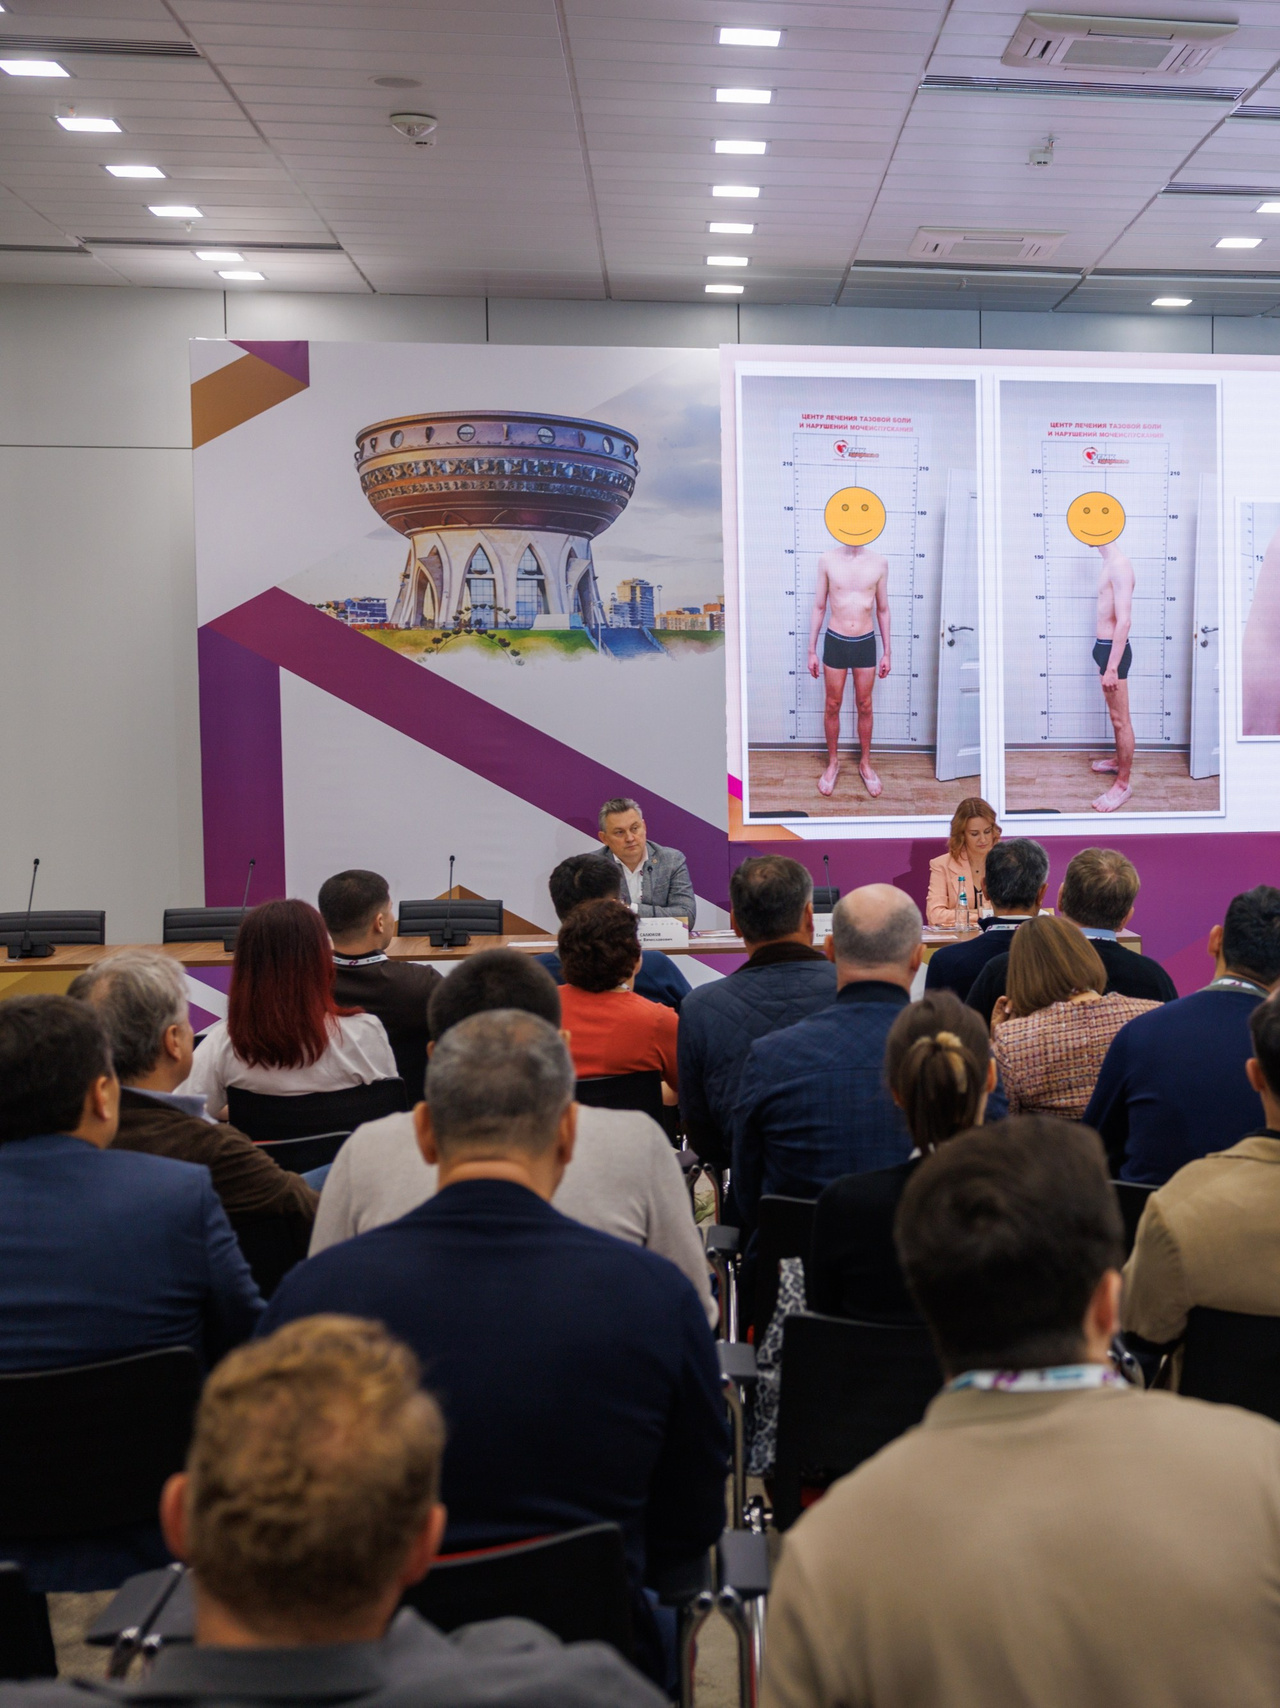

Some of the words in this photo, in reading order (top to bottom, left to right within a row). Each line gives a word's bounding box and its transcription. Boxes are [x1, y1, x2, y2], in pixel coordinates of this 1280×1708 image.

[859, 415, 891, 423] ТАЗОВОЙ
[805, 422, 848, 430] НАРУШЕНИЙ
[849, 424, 914, 433] МОЧЕИСПУСКАНИЯ
[1109, 422, 1141, 430] ТАЗОВОЙ
[1099, 431, 1164, 439] МОЧЕИСПУСКАНИЯ
